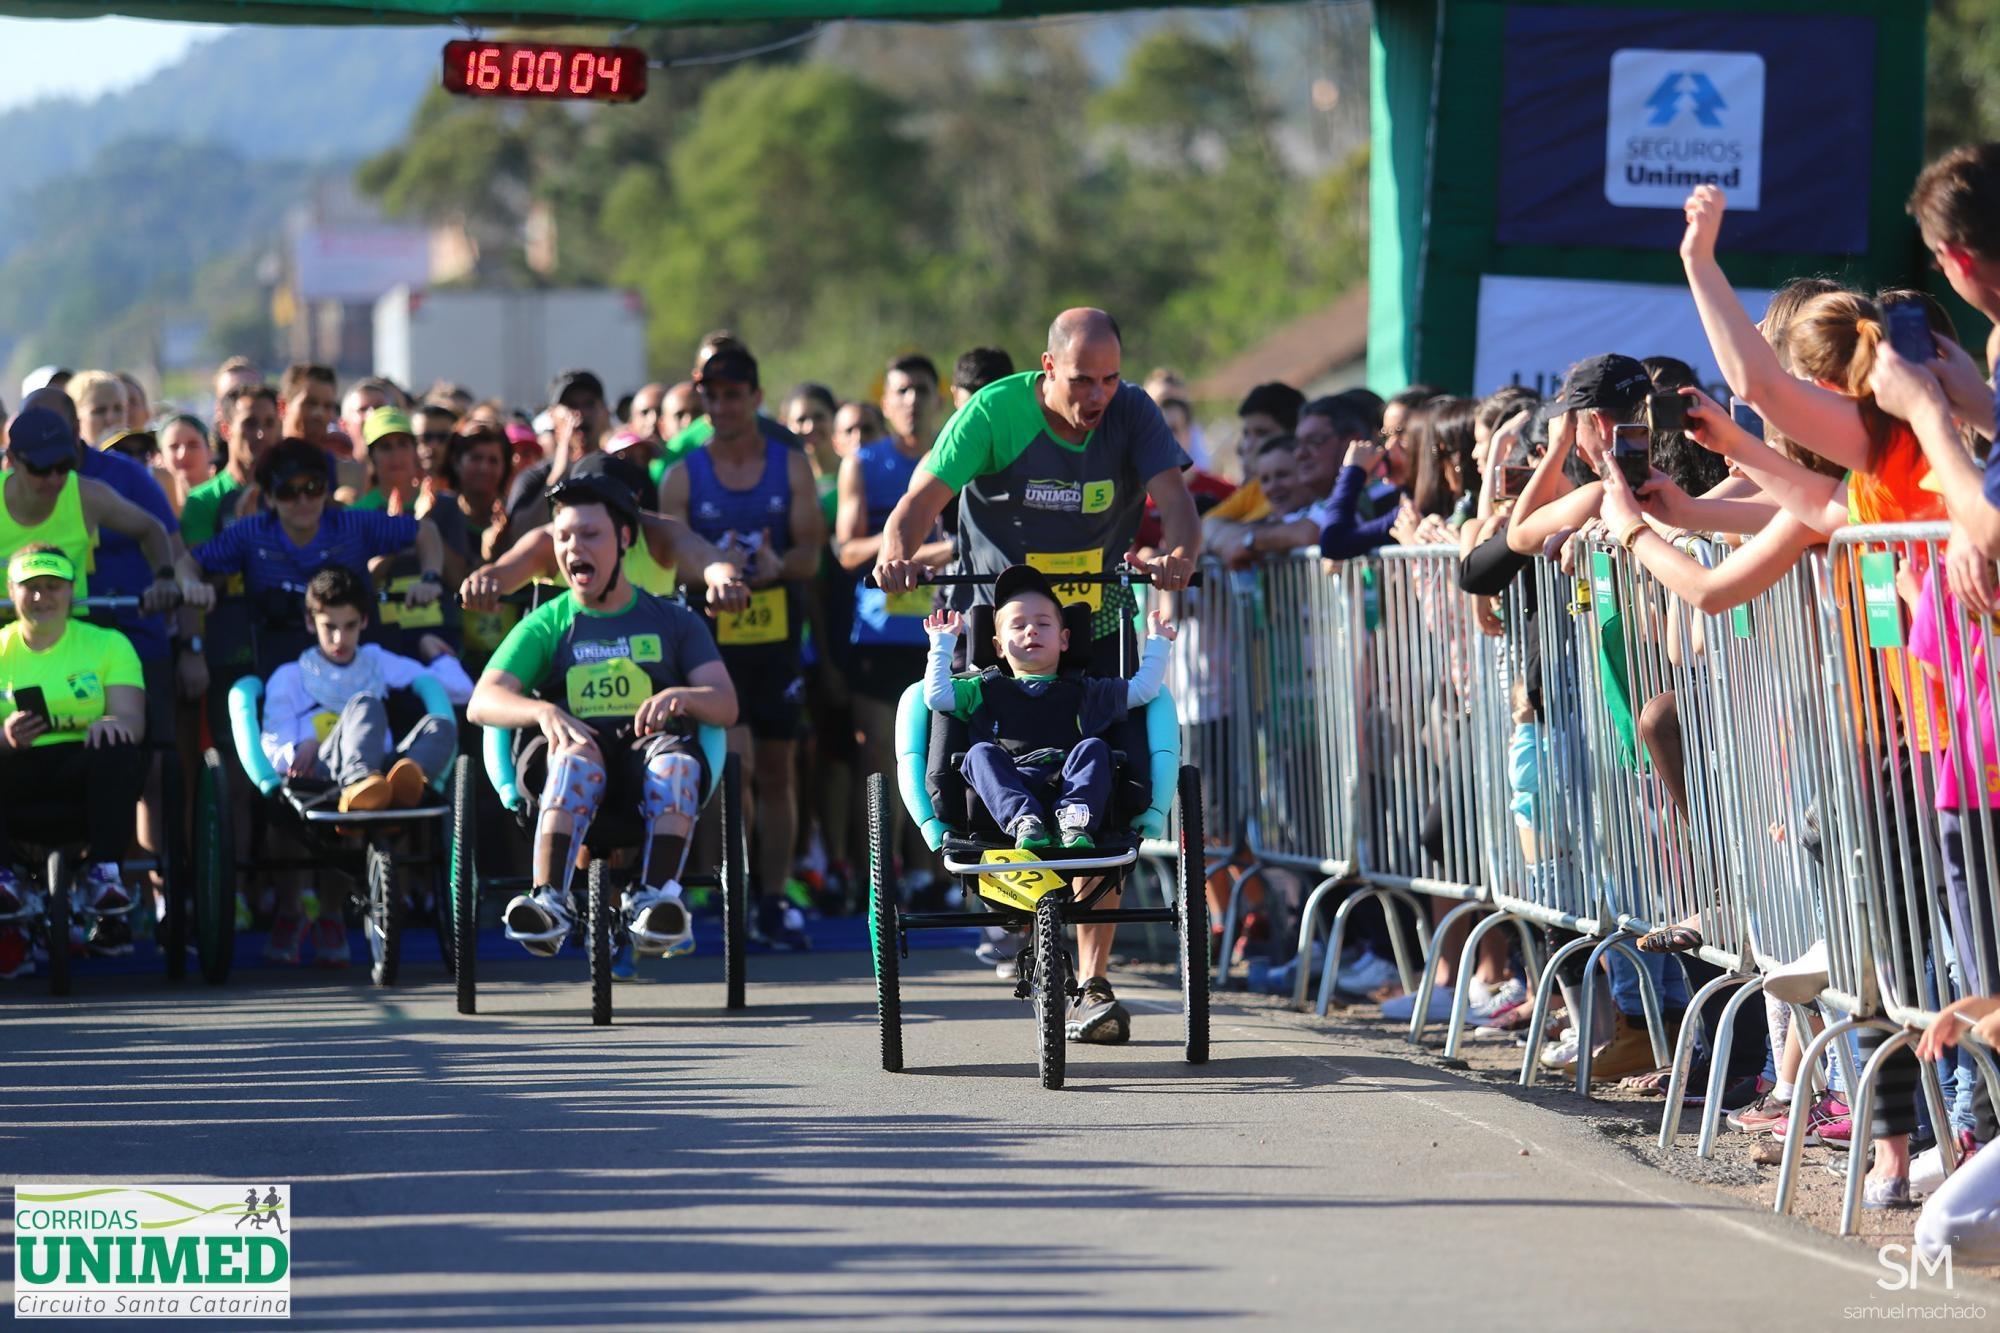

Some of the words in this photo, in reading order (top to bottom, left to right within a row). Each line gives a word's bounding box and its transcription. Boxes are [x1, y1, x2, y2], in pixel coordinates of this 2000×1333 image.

[466, 49, 501, 90] 16
[510, 50, 562, 92] 00
[569, 53, 622, 94] 04
[1626, 137, 1742, 163] SEGUROS
[1626, 164, 1741, 188] Unimed
[1025, 489, 1081, 502] UNIMED
[1095, 489, 1105, 502] 5
[581, 675, 630, 700] 450
